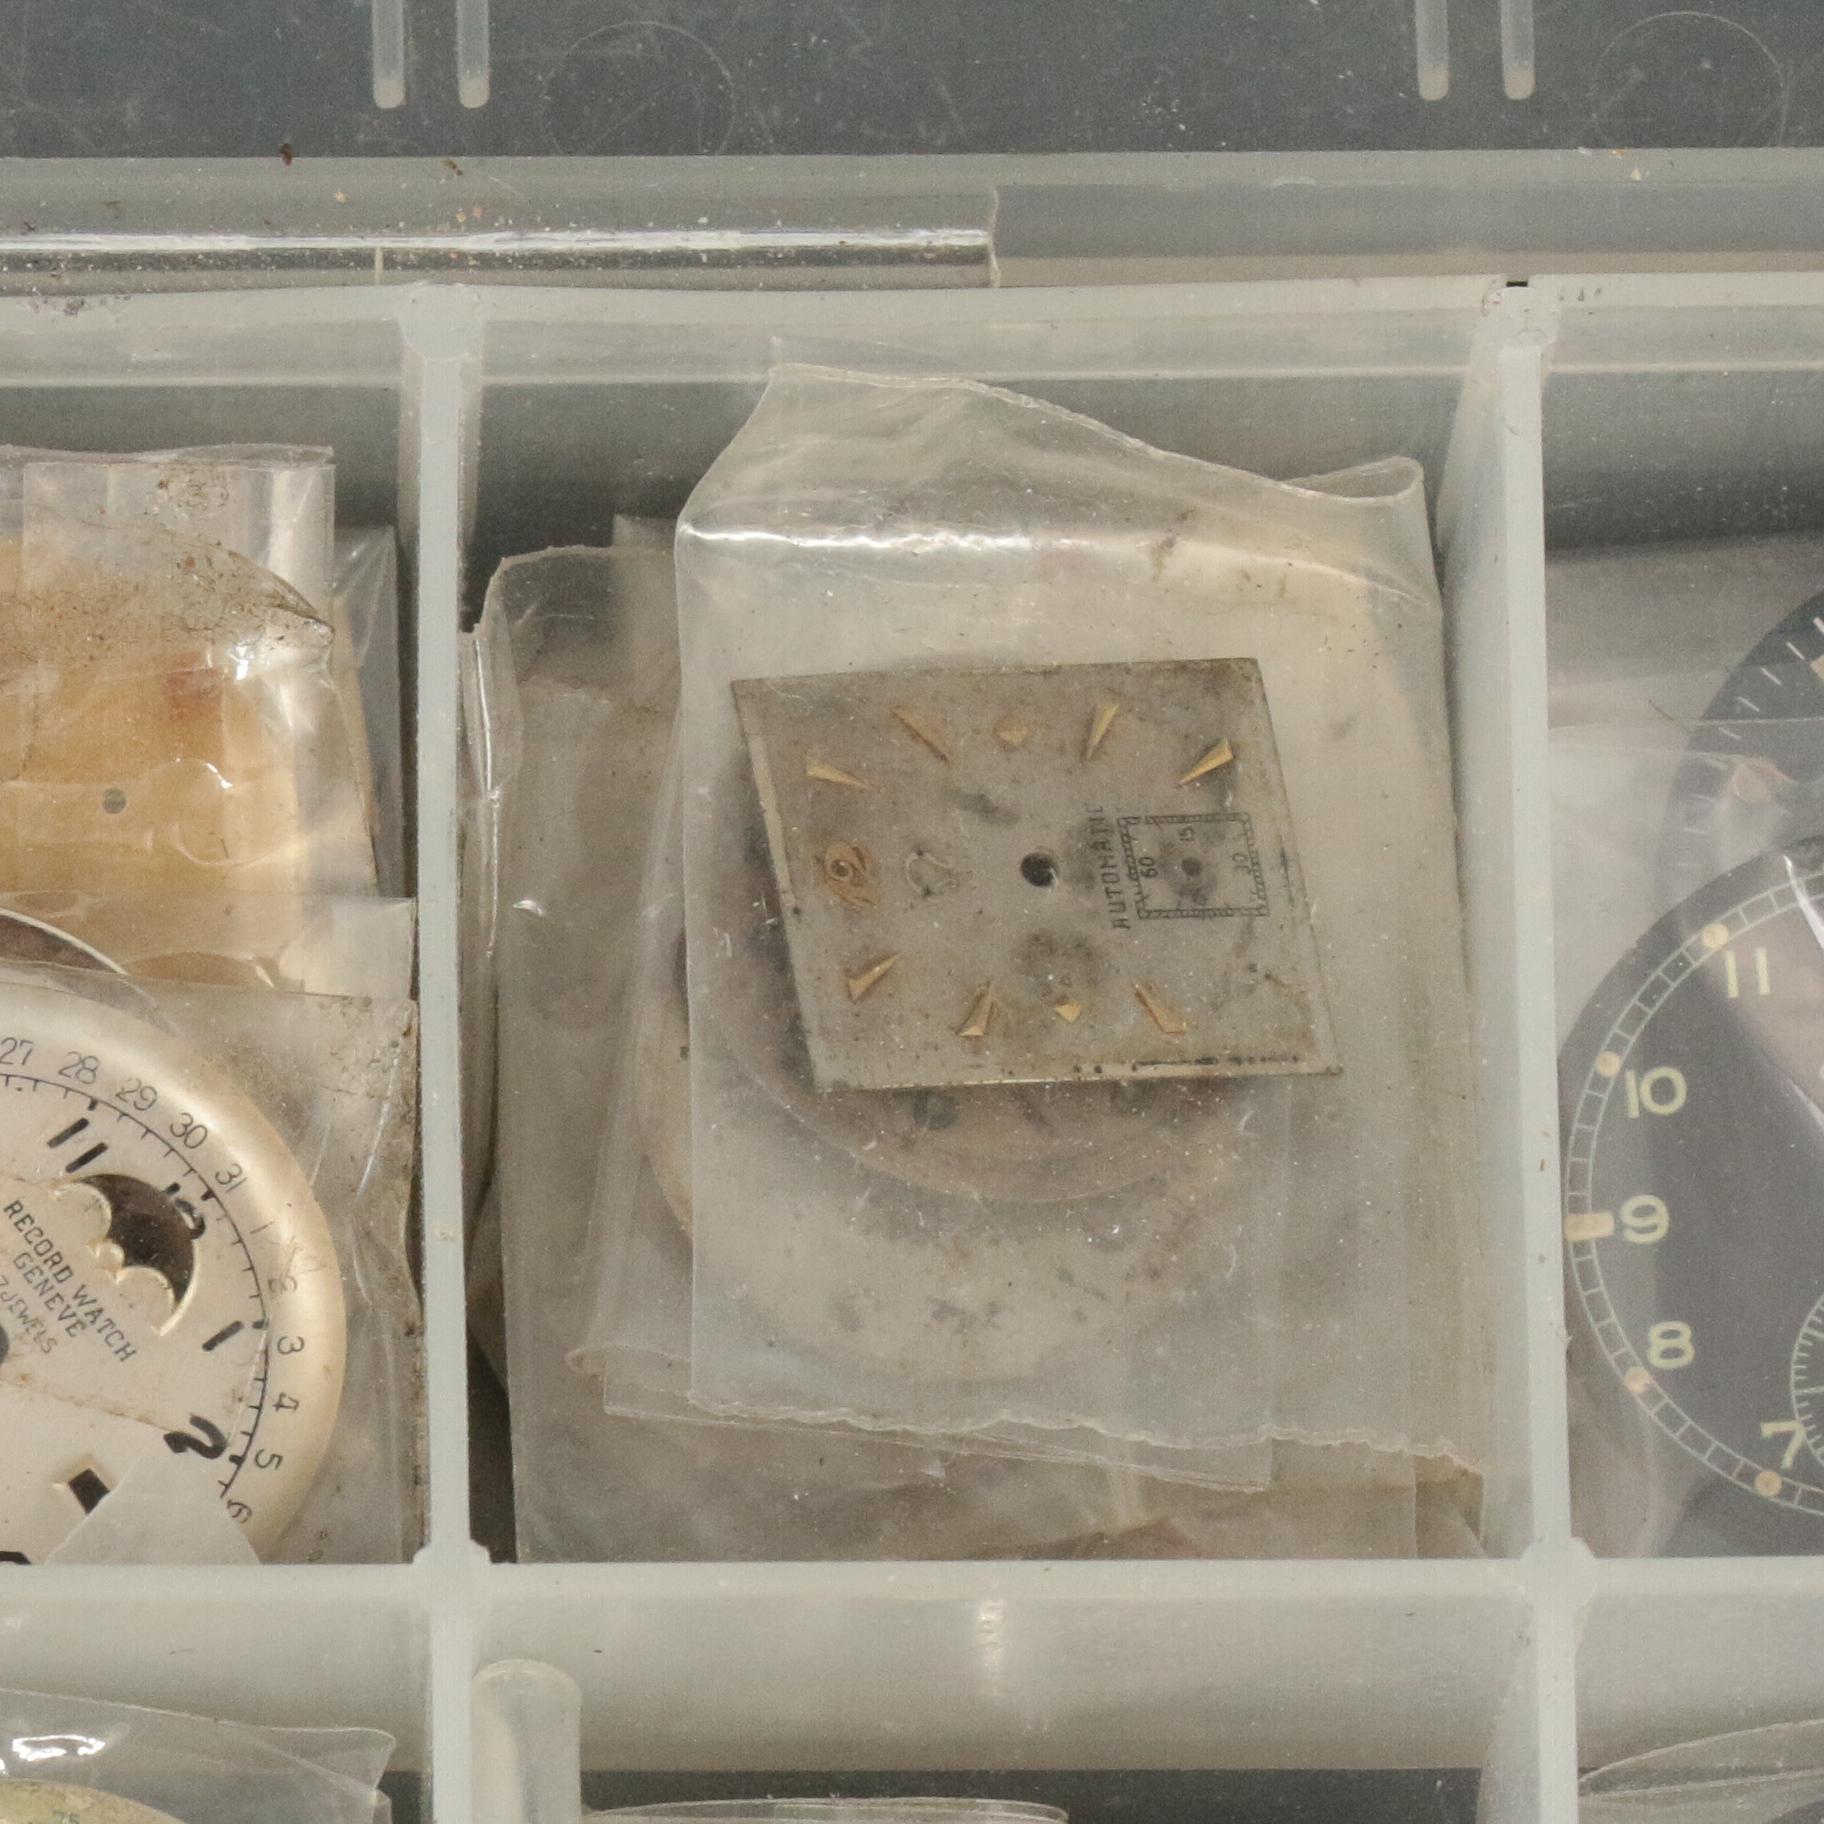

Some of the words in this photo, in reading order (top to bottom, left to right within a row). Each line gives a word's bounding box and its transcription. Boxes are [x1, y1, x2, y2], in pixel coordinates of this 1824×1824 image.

[1179, 825, 1195, 843] 15
[1086, 804, 1131, 931] AUTOMATIC
[1139, 855, 1160, 879] 60
[1232, 850, 1251, 874] 30
[1726, 946, 1771, 998] 11
[58, 1050, 101, 1085] 28
[115, 1076, 158, 1112] 29
[1626, 1065, 1688, 1119] 10
[46, 1116, 109, 1174] 11
[169, 1111, 209, 1150] 30
[215, 1162, 249, 1193] 31
[1620, 1193, 1671, 1245] 9
[2, 1199, 74, 1286] RECORD
[71, 1284, 138, 1363] WATCH
[12, 1250, 88, 1339] GENEVE
[201, 1320, 245, 1353] 1
[277, 1334, 305, 1356] 3
[1647, 1320, 1696, 1370] 8
[275, 1391, 300, 1412] 4
[163, 1414, 229, 1460] 2
[1759, 1419, 1809, 1470] 7
[254, 1448, 284, 1471] 5
[227, 1500, 253, 1525] 6
